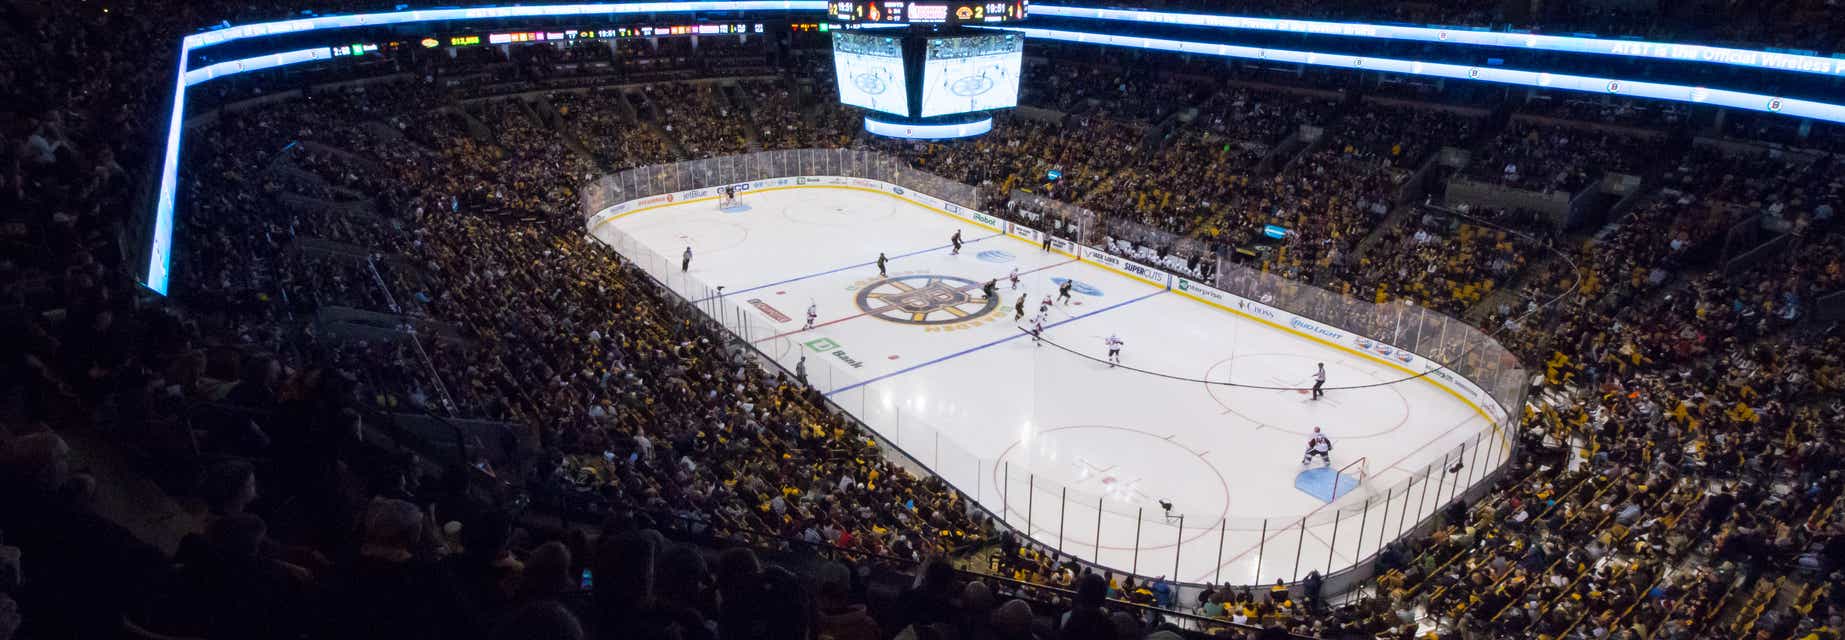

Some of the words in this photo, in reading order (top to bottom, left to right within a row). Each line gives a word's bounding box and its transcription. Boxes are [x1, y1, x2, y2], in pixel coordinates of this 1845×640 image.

[974, 6, 984, 18] 2
[1761, 53, 1831, 72] Wireless
[717, 183, 750, 195] GCO
[832, 350, 864, 369] Bank
